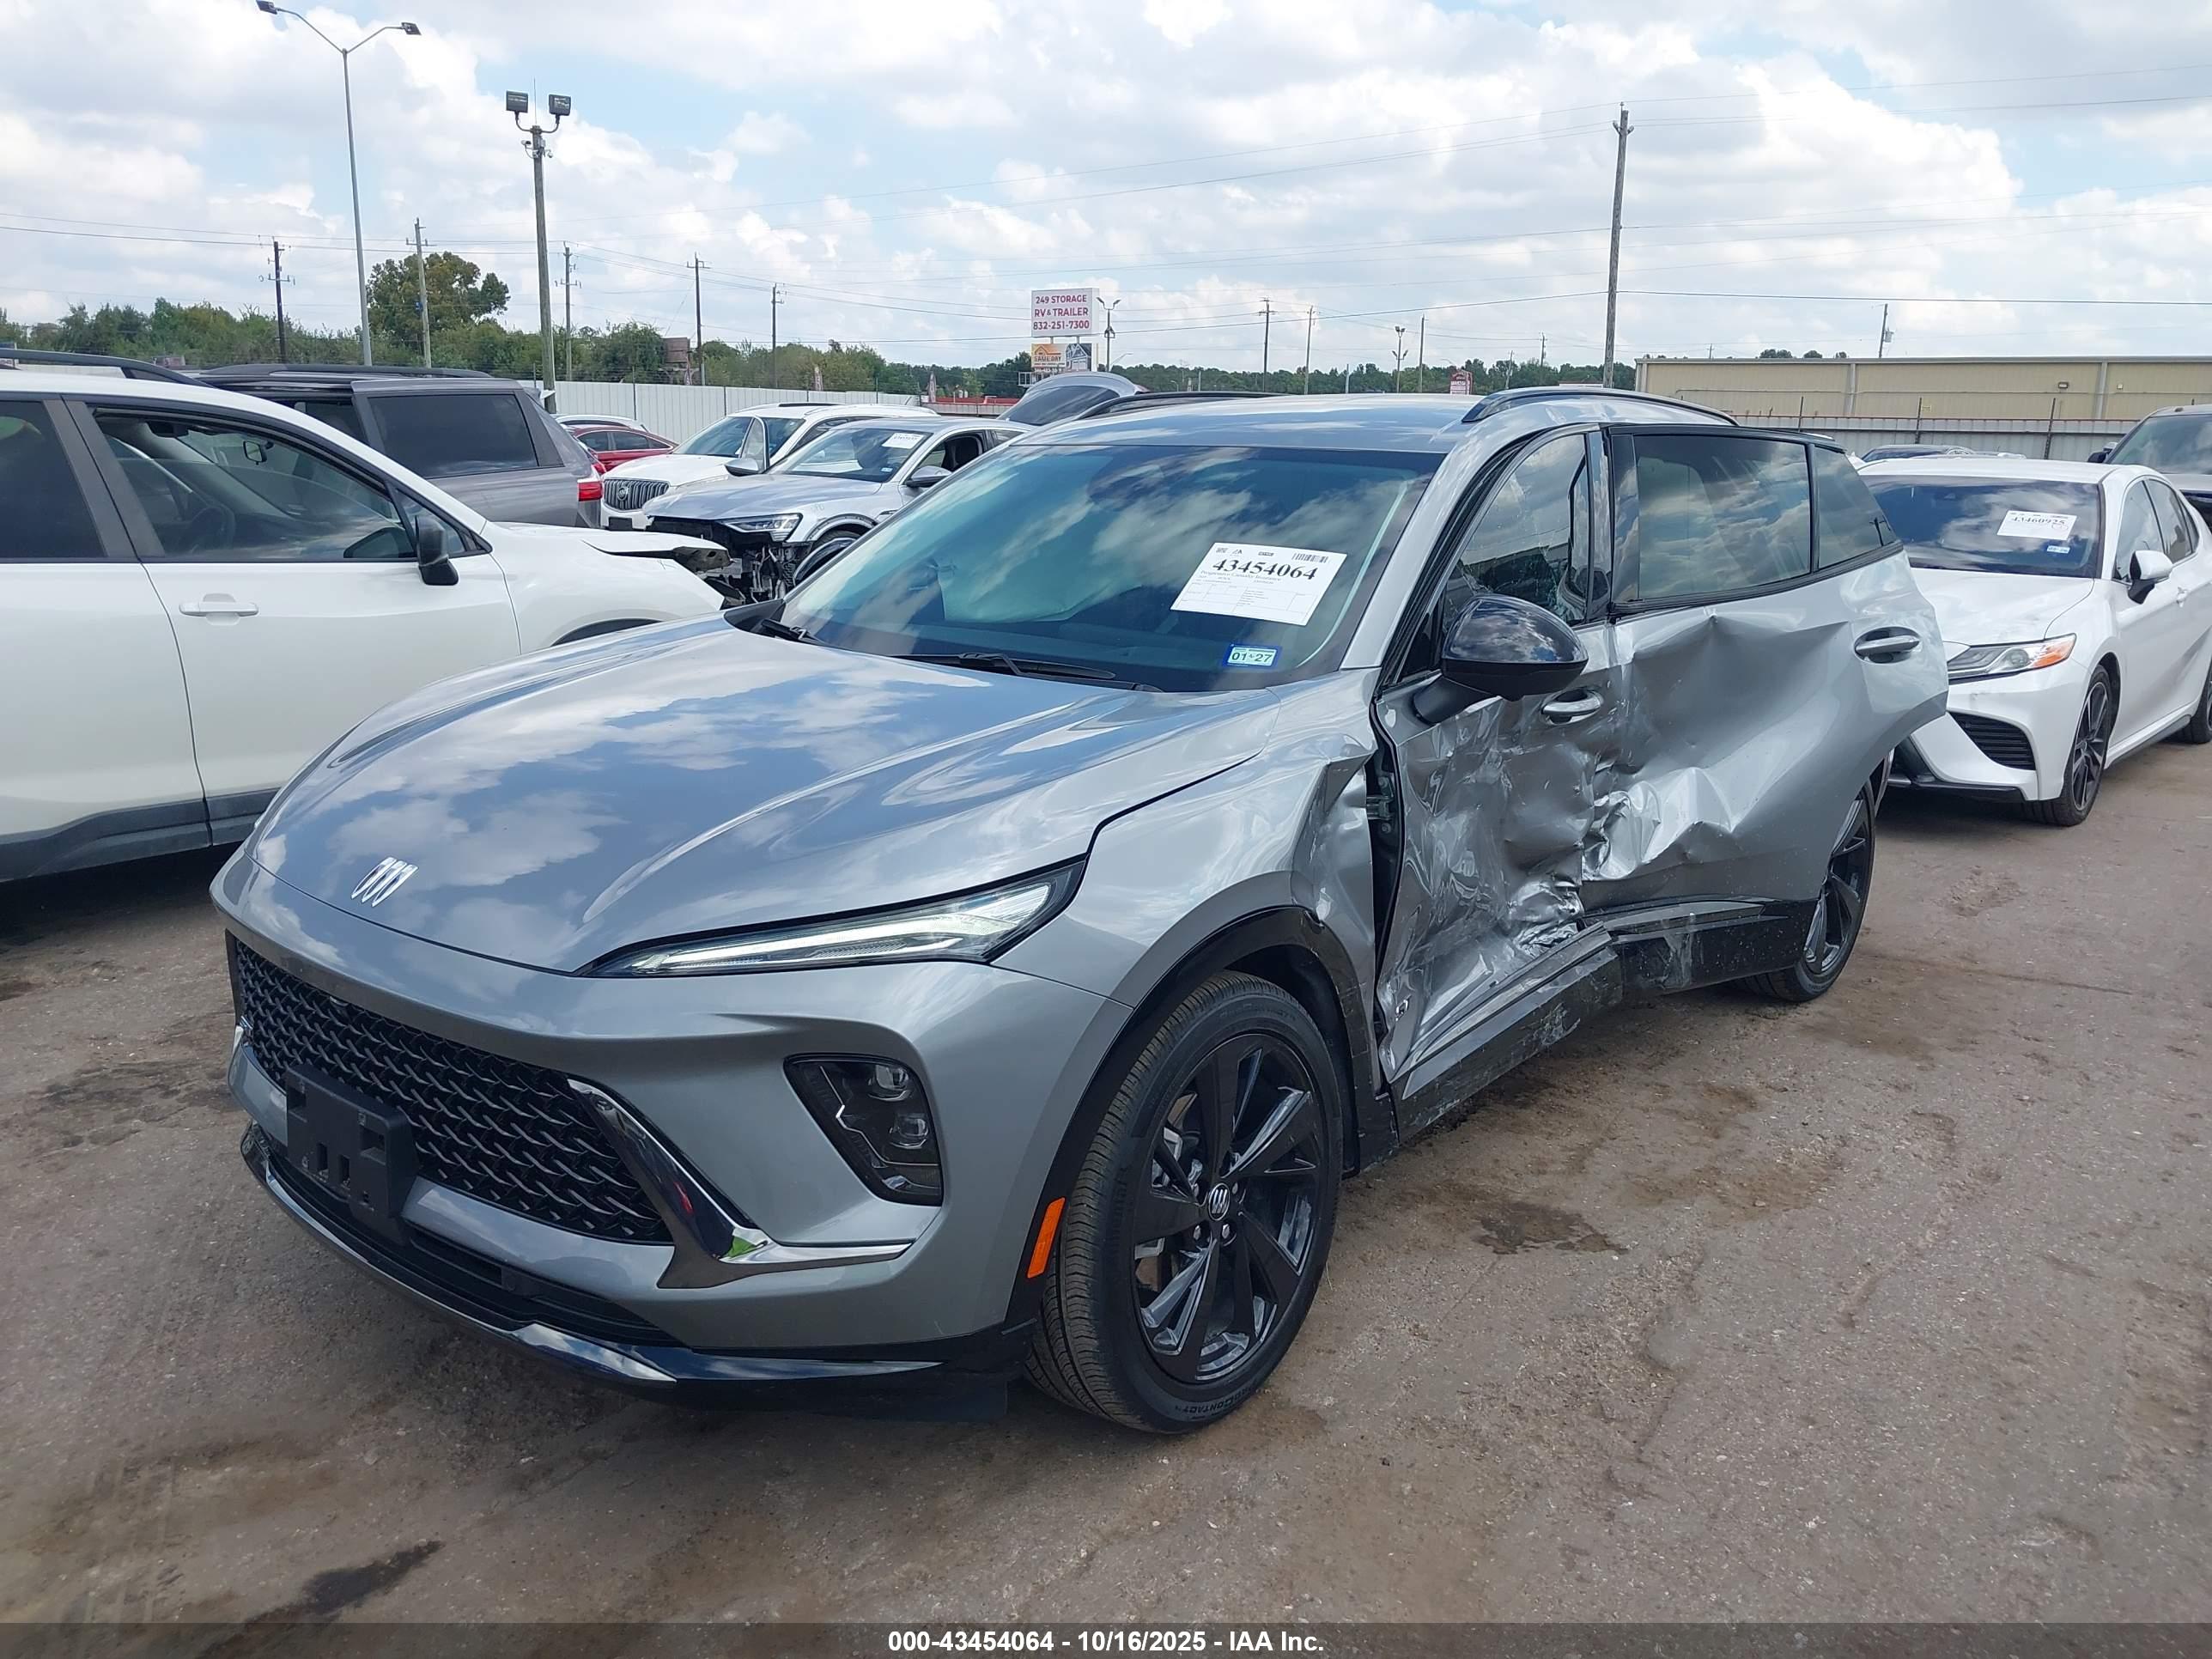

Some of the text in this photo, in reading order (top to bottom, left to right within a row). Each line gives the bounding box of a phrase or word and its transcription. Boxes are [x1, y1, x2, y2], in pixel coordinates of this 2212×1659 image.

[1051, 295, 1087, 304] STORAGE
[1034, 308, 1046, 317] RV
[1053, 307, 1089, 317] TRAILER
[1033, 320, 1090, 330] 832-251-7300
[1212, 559, 1318, 580] 43454064
[1231, 652, 1273, 663] 01 27
